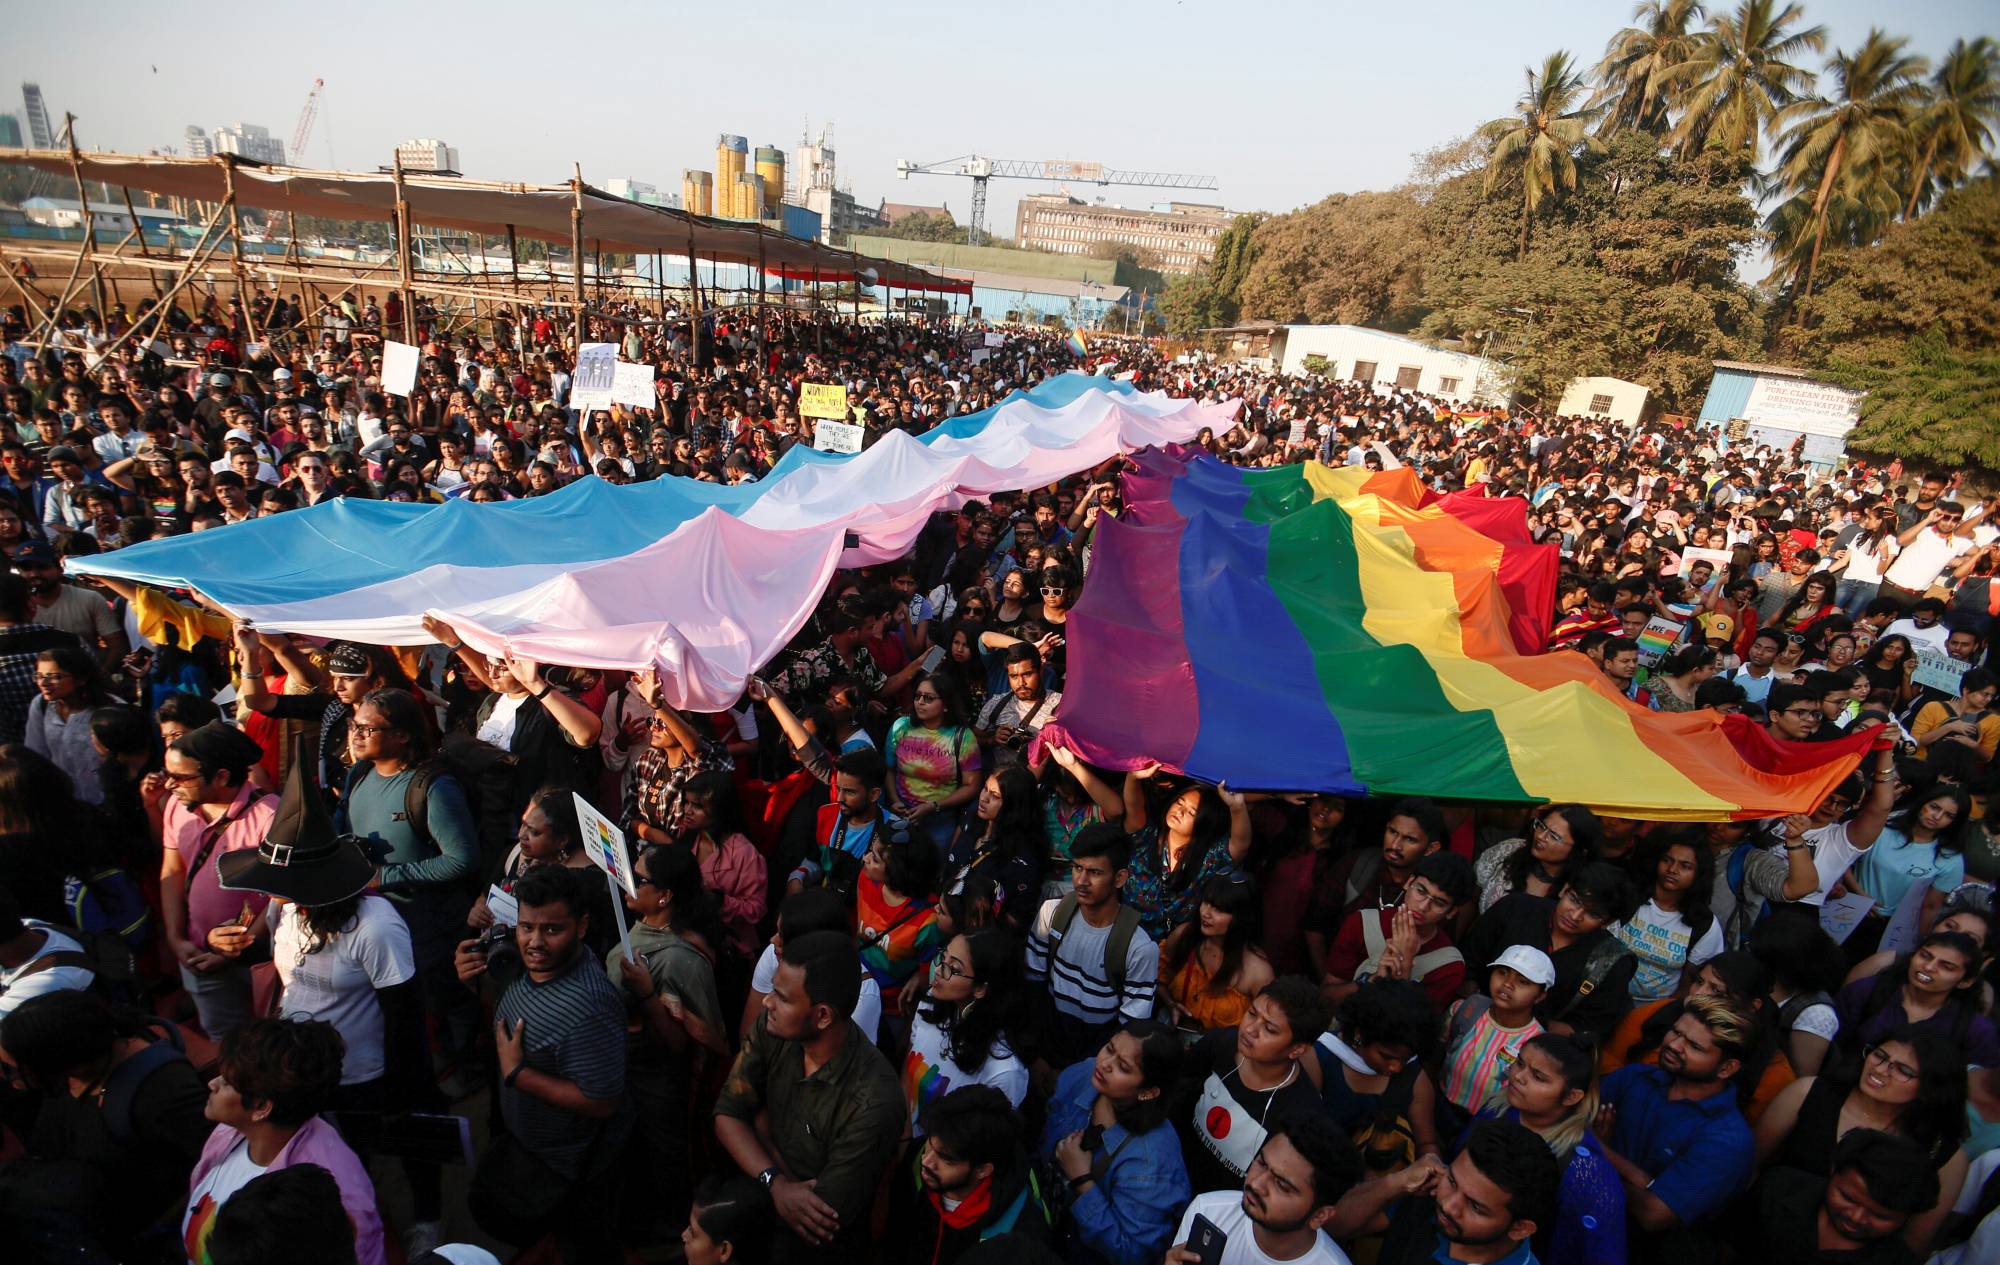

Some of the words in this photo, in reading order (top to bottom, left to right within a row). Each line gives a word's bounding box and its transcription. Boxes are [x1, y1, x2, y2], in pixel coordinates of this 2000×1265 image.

[1647, 623, 1666, 634] LOVE
[1647, 923, 1670, 940] COOL
[1633, 940, 1652, 953] COOL
[1222, 1157, 1244, 1178] JAPAN
